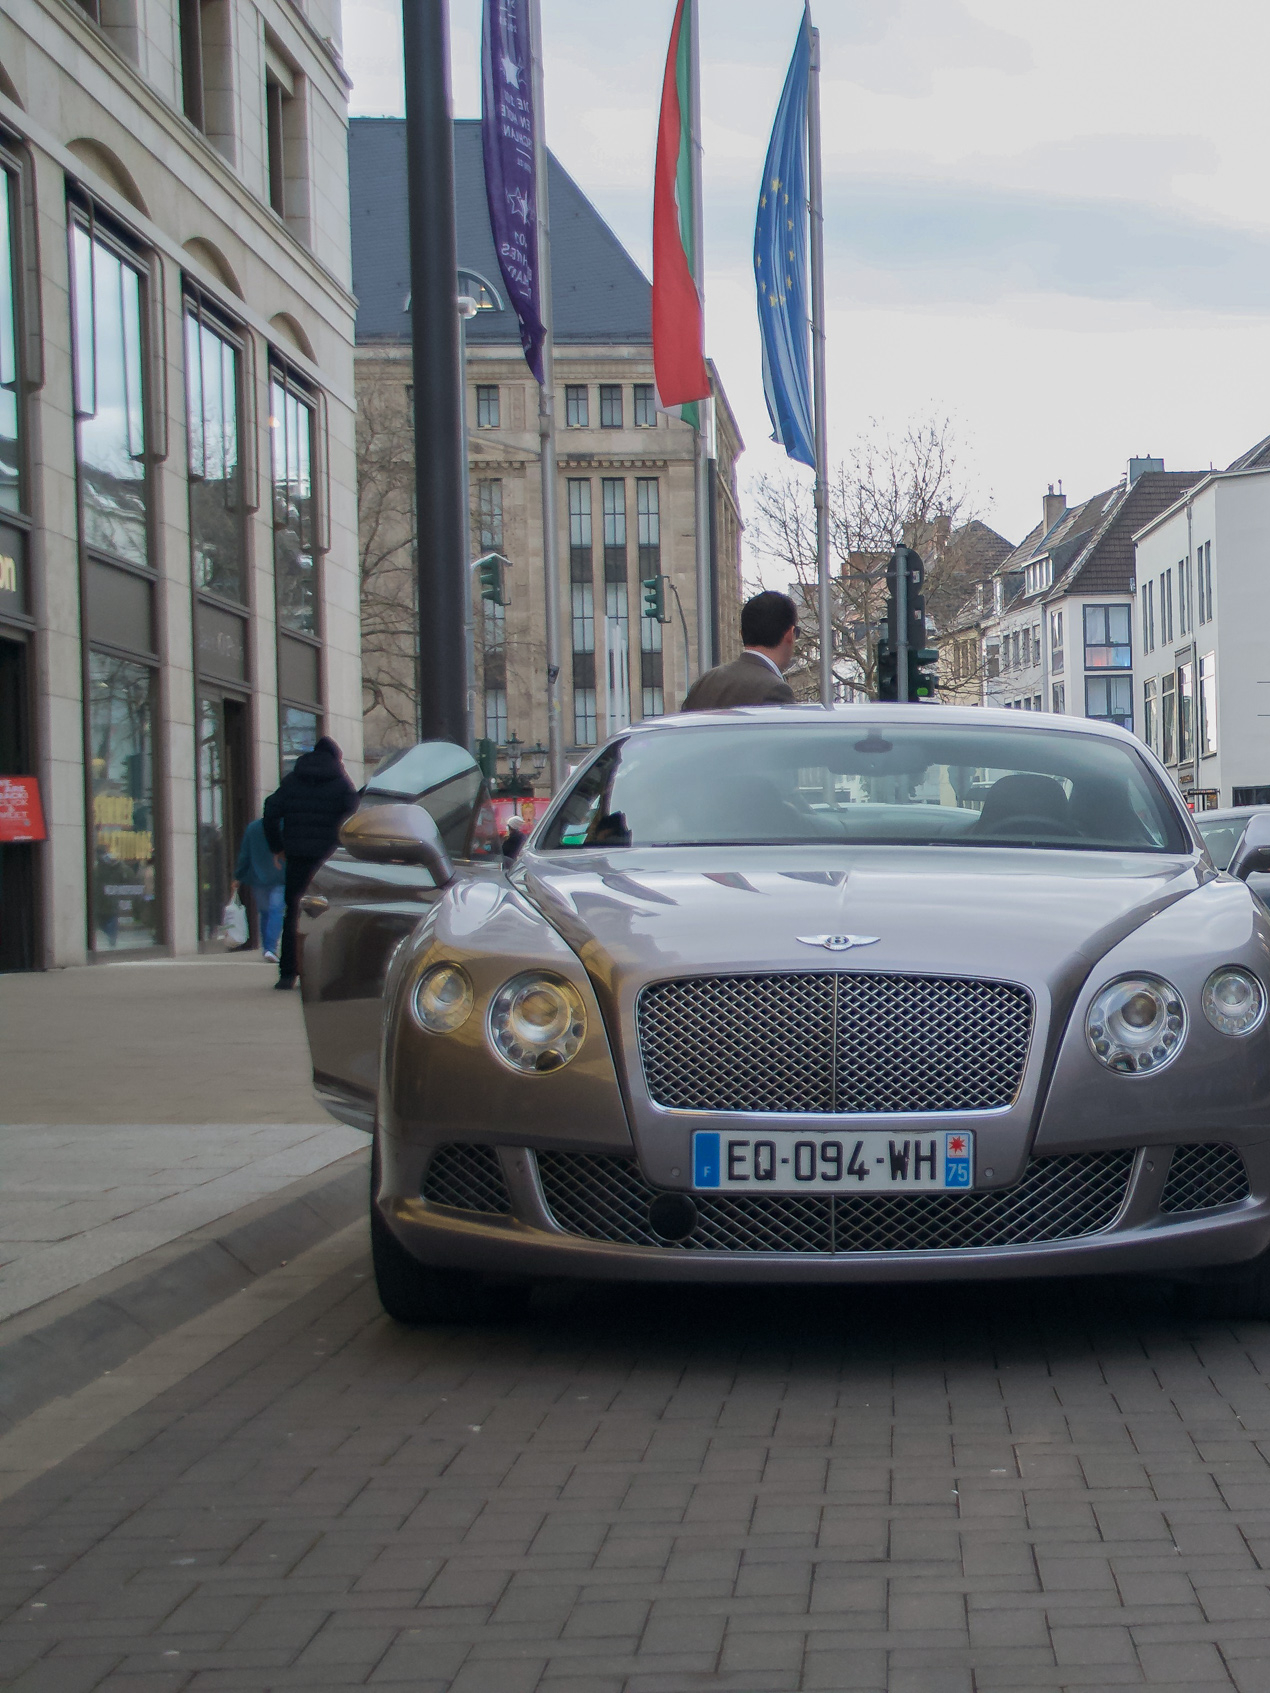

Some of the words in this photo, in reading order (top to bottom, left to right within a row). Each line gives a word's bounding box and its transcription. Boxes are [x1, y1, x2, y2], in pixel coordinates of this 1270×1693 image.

[728, 1139, 937, 1181] EQ-094-WH
[703, 1166, 712, 1178] F
[947, 1163, 969, 1182] 75
